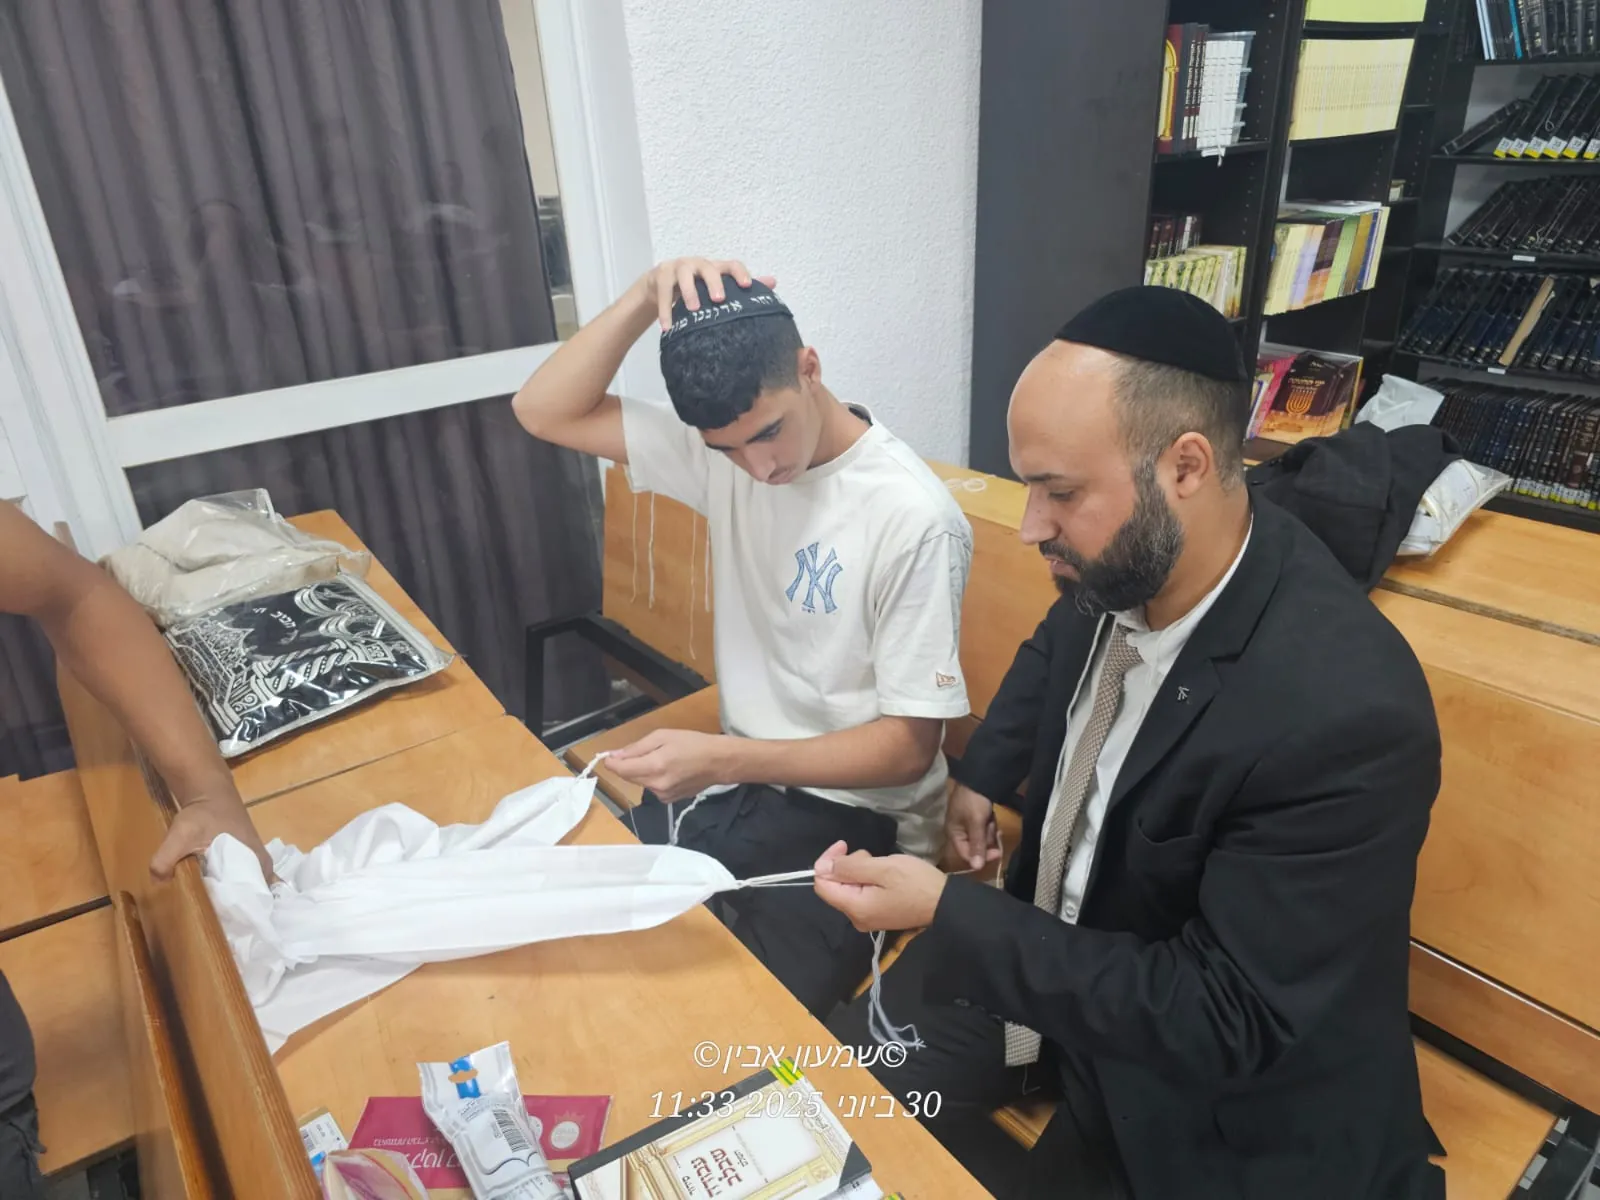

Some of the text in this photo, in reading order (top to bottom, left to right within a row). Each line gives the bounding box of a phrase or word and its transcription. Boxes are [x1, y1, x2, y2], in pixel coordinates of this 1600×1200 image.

[785, 542, 843, 614] NY
[681, 1175, 696, 1196] סידור
[691, 1156, 723, 1198] עבודה
[710, 1148, 743, 1187] שבלב
